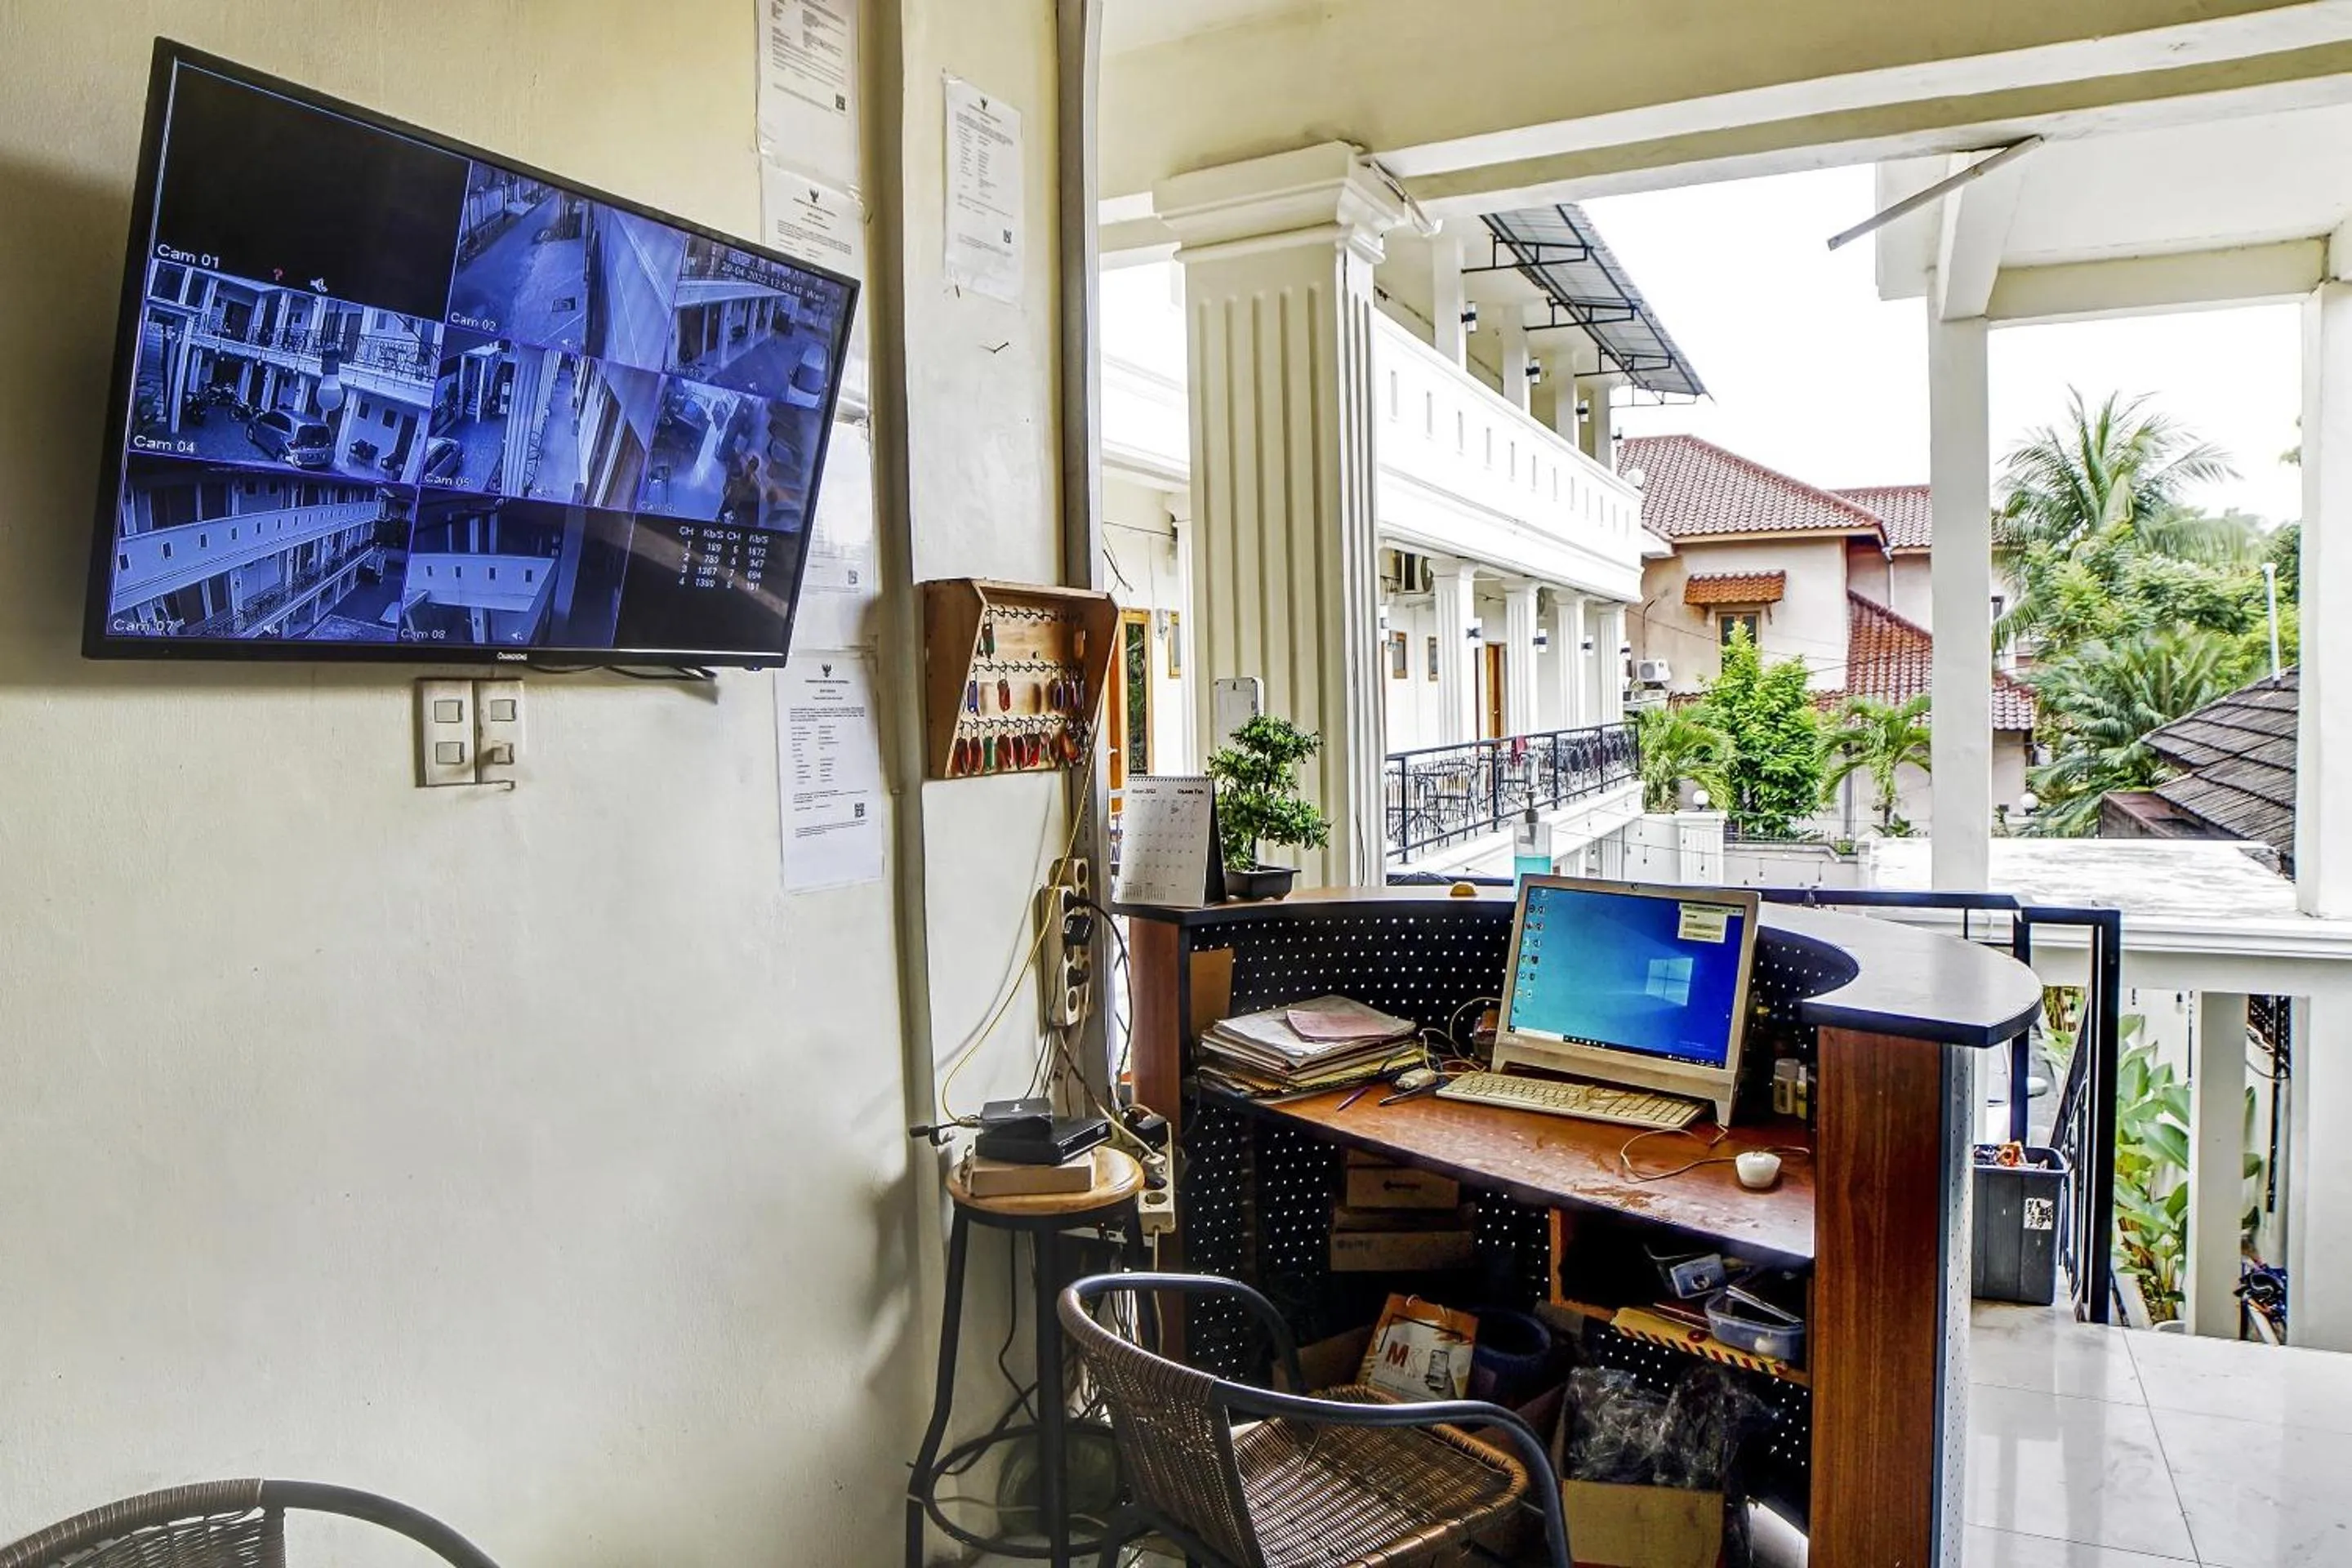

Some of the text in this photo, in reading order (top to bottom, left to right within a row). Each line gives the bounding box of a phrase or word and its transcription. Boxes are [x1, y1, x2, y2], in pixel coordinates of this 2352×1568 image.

[158, 244, 220, 269] Cam 01
[451, 312, 497, 332] Cam 02
[134, 434, 196, 453] Cam 04
[425, 473, 452, 486] Cam
[679, 526, 693, 536] CH
[727, 531, 741, 541] CH
[683, 553, 690, 562] 2
[681, 564, 688, 573] 3
[113, 618, 174, 632] Cam 07
[400, 628, 429, 641] Cam
